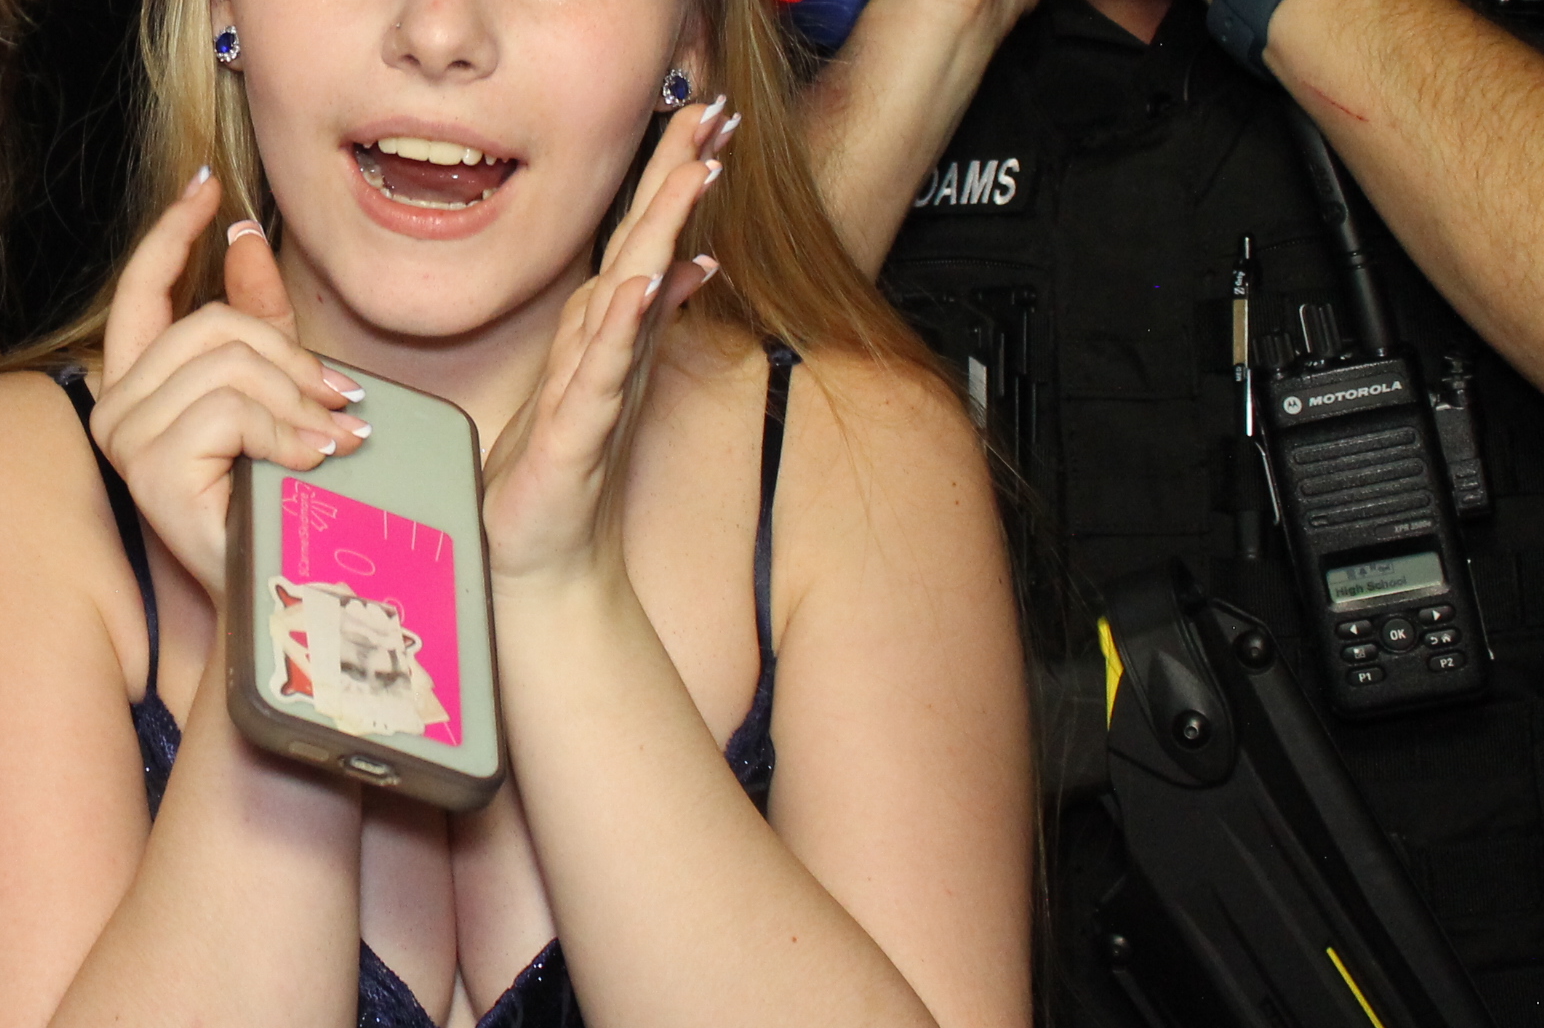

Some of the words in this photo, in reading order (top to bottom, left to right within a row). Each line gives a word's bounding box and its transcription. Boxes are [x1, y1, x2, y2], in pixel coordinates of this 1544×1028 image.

[1309, 381, 1402, 407] MOTOROLA
[1335, 584, 1364, 598] High
[1367, 576, 1407, 591] School
[1389, 629, 1406, 641] OK
[1439, 658, 1454, 668] P2
[1358, 672, 1372, 683] P1
